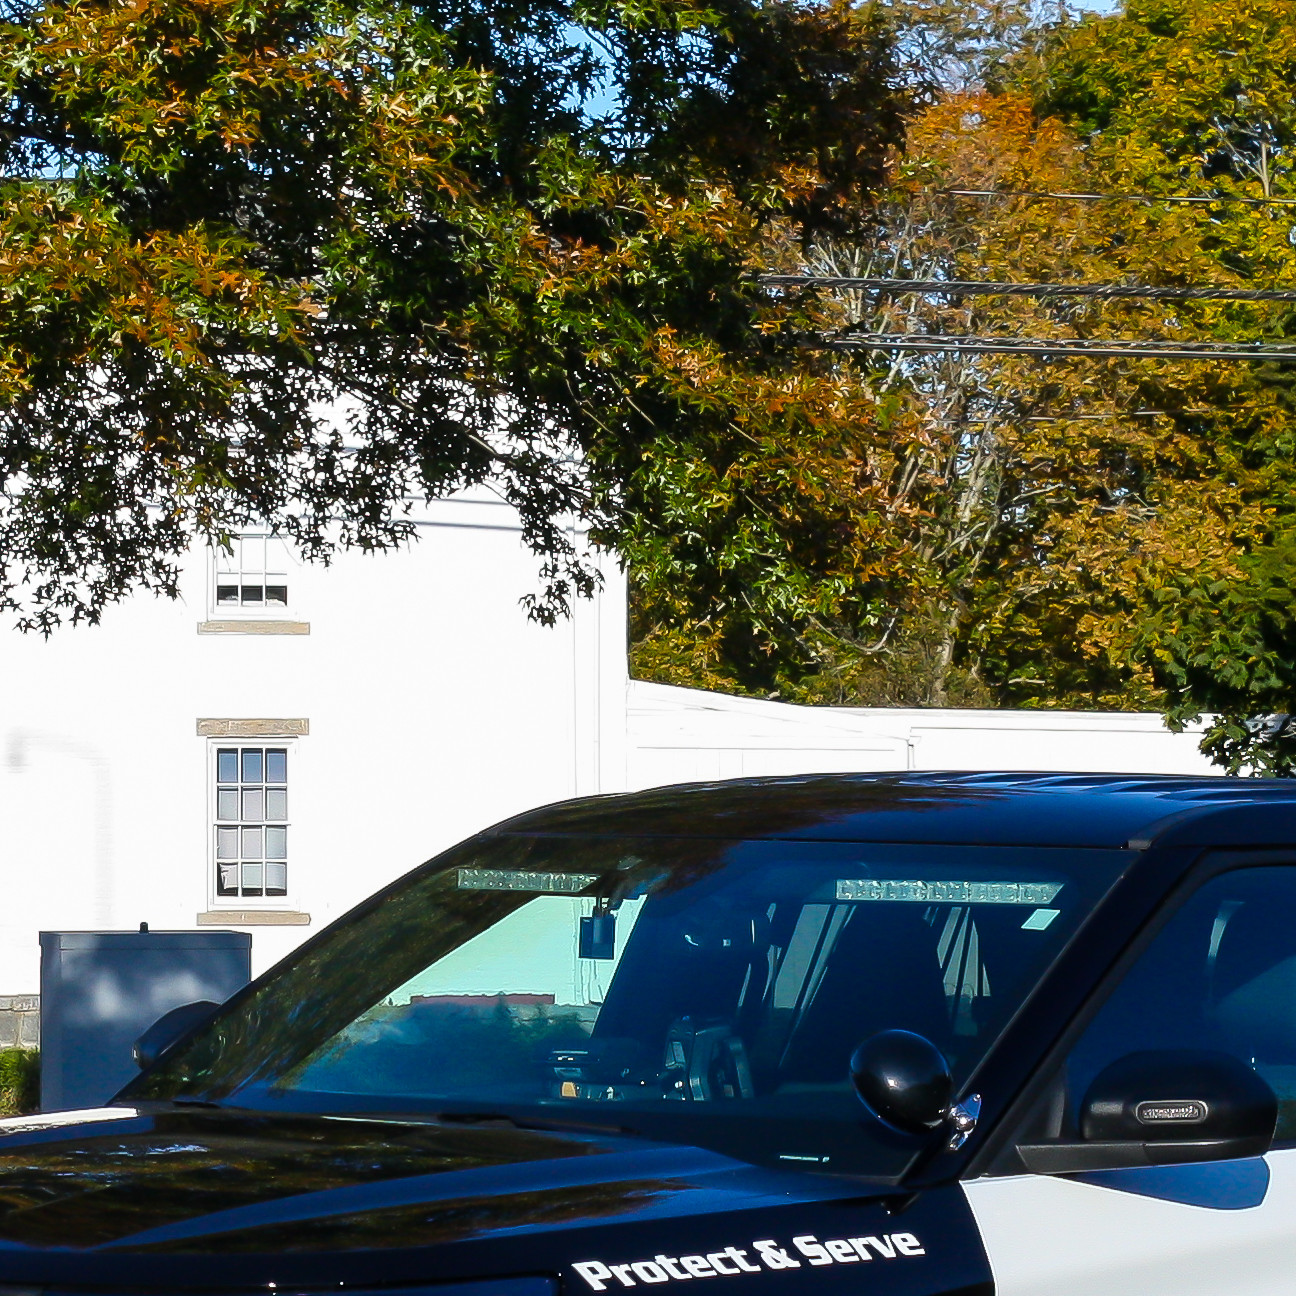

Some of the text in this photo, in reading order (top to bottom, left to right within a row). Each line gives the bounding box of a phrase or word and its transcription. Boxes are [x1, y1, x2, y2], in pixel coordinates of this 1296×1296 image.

[571, 1231, 926, 1291] Protect & Serve
